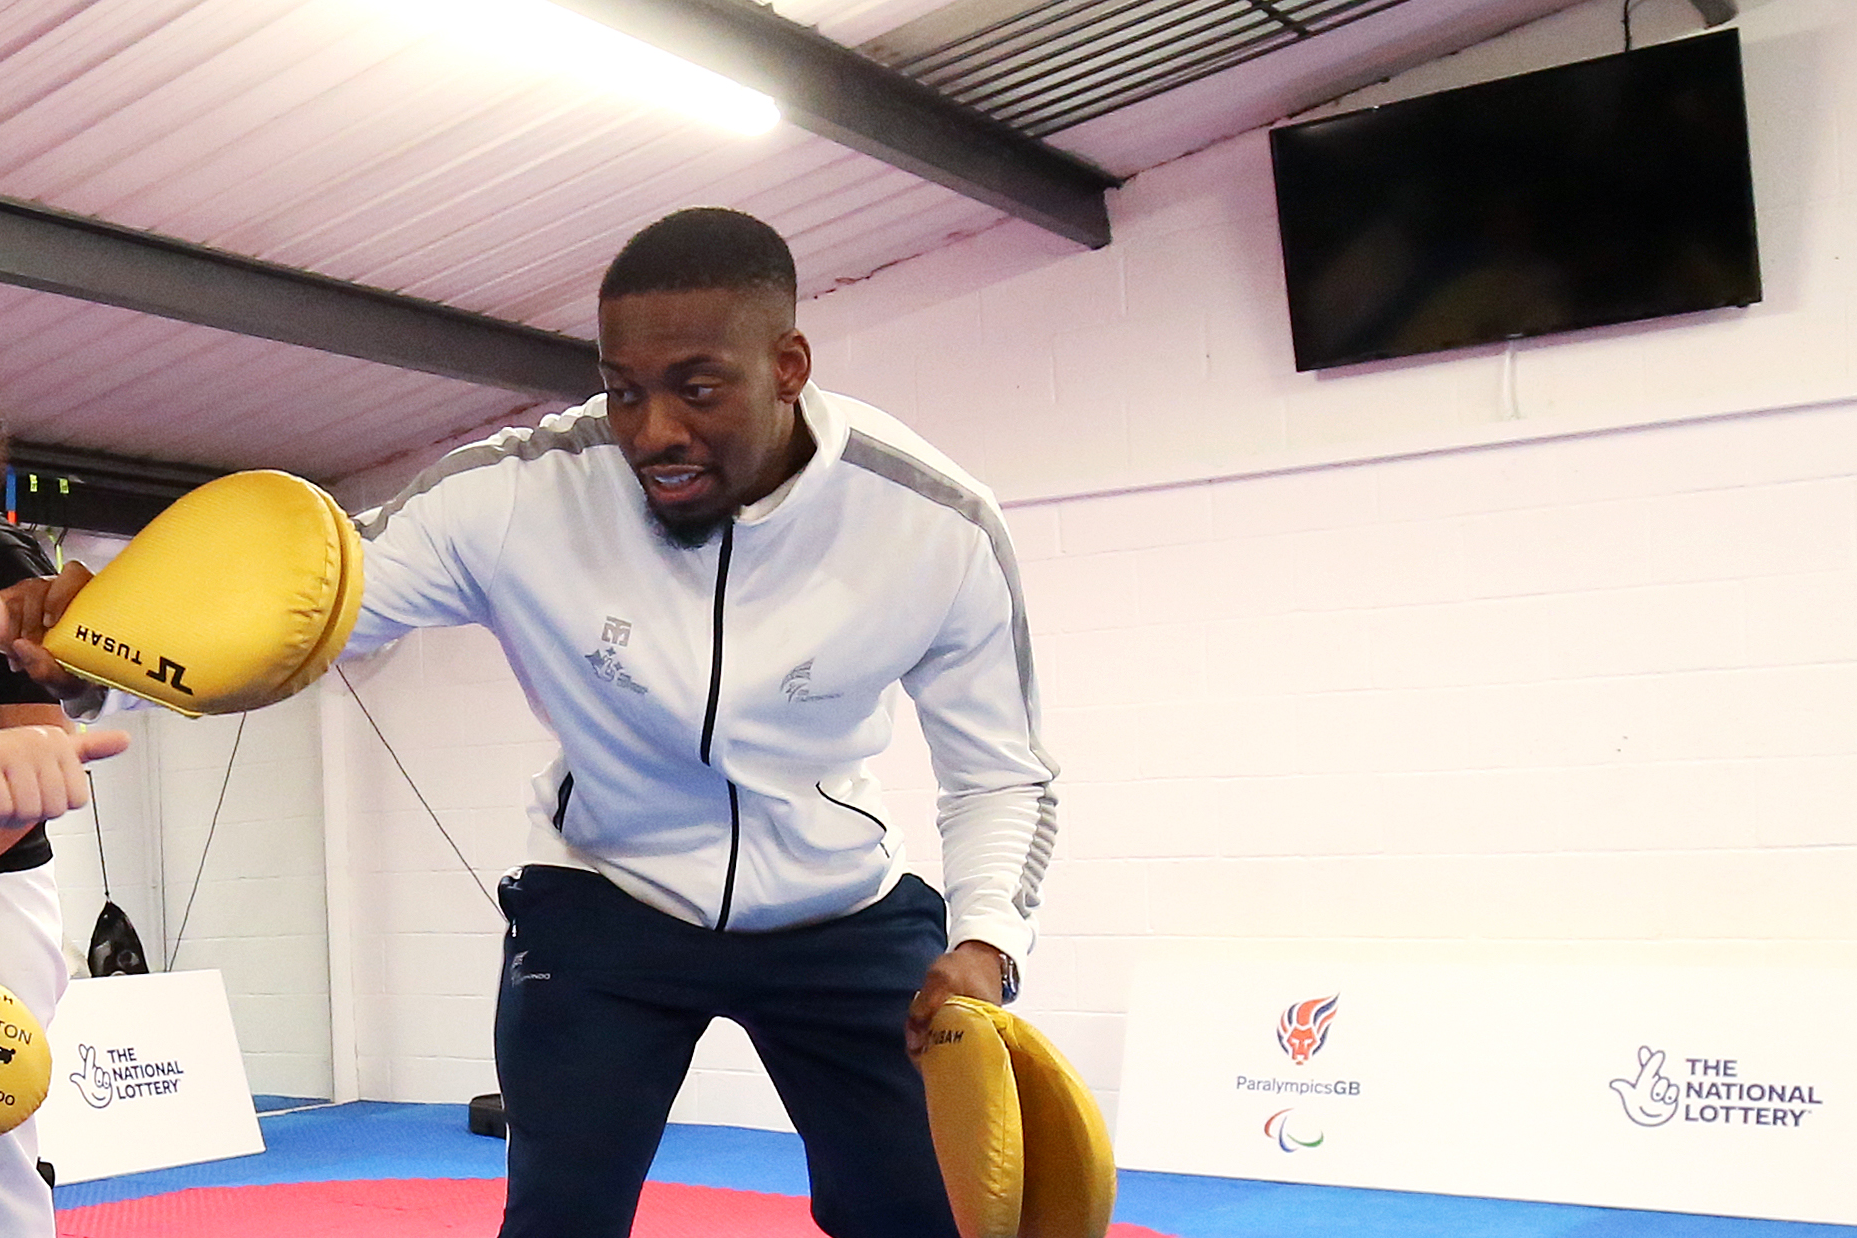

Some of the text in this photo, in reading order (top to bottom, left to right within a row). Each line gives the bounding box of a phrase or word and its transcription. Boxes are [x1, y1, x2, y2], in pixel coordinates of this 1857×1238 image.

[75, 625, 142, 665] TUSAH
[107, 1047, 137, 1063] THE
[112, 1061, 184, 1082] NATIONAL
[1686, 1058, 1738, 1077] THE
[116, 1079, 179, 1099] LOTTERY
[1236, 1075, 1361, 1096] ParalympicsGB
[1686, 1081, 1823, 1105] NATIONAL
[1685, 1104, 1807, 1127] LOTTERY
